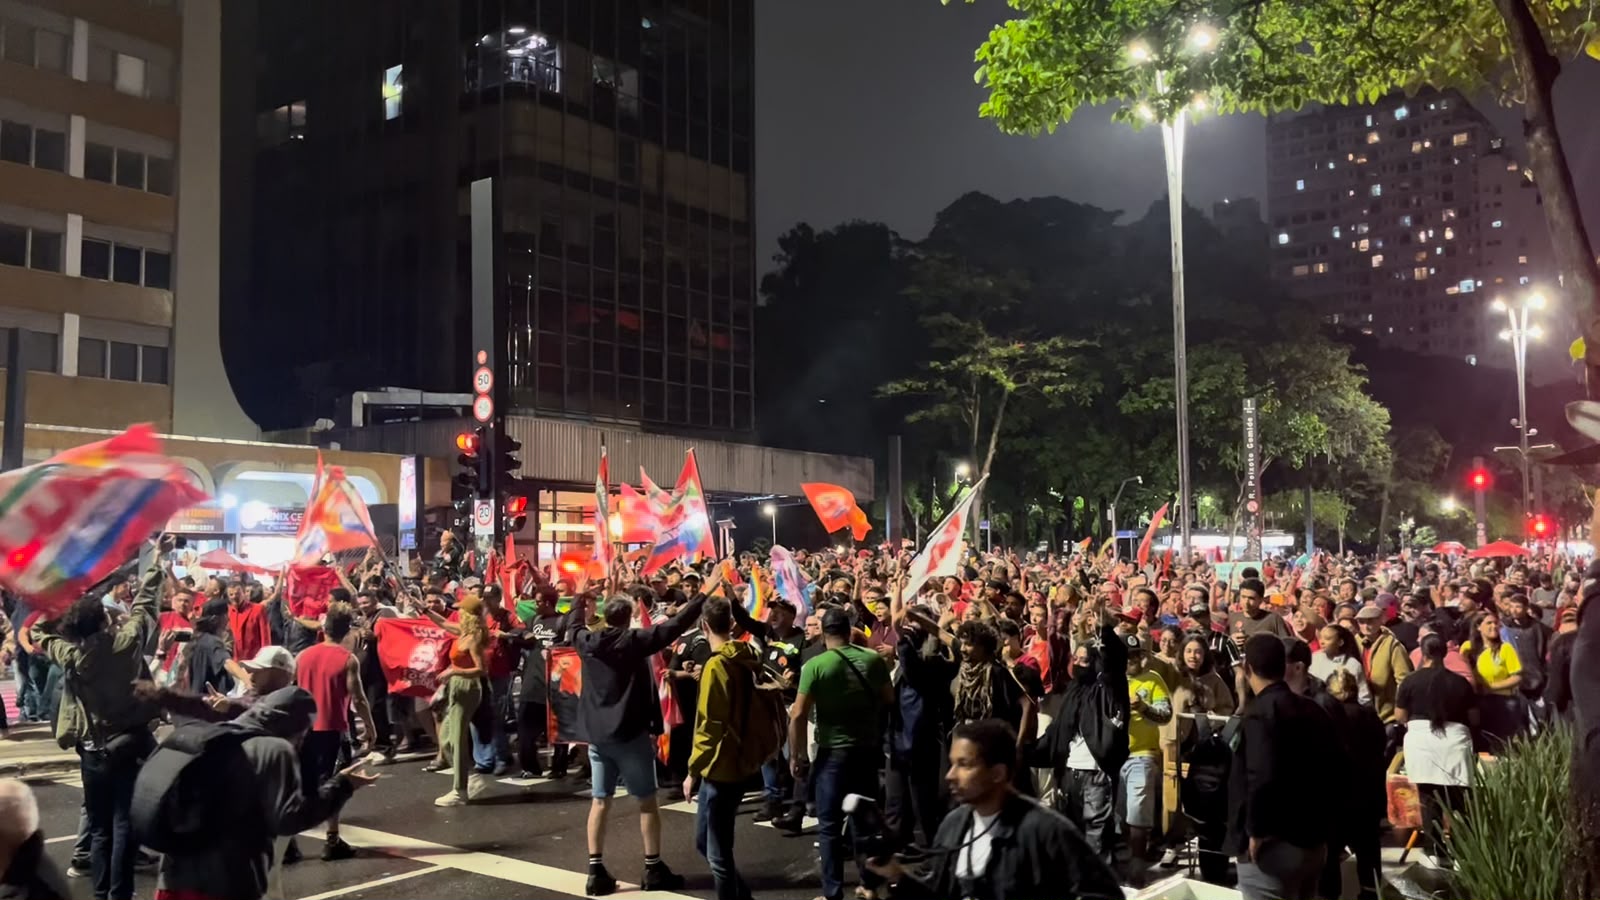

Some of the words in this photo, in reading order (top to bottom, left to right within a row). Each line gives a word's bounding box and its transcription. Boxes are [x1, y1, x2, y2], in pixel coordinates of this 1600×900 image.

[478, 374, 489, 386] 50
[1246, 417, 1254, 449] Gomide
[1248, 452, 1256, 488] Peixoto
[1248, 489, 1256, 500] R.
[479, 507, 490, 518] 20
